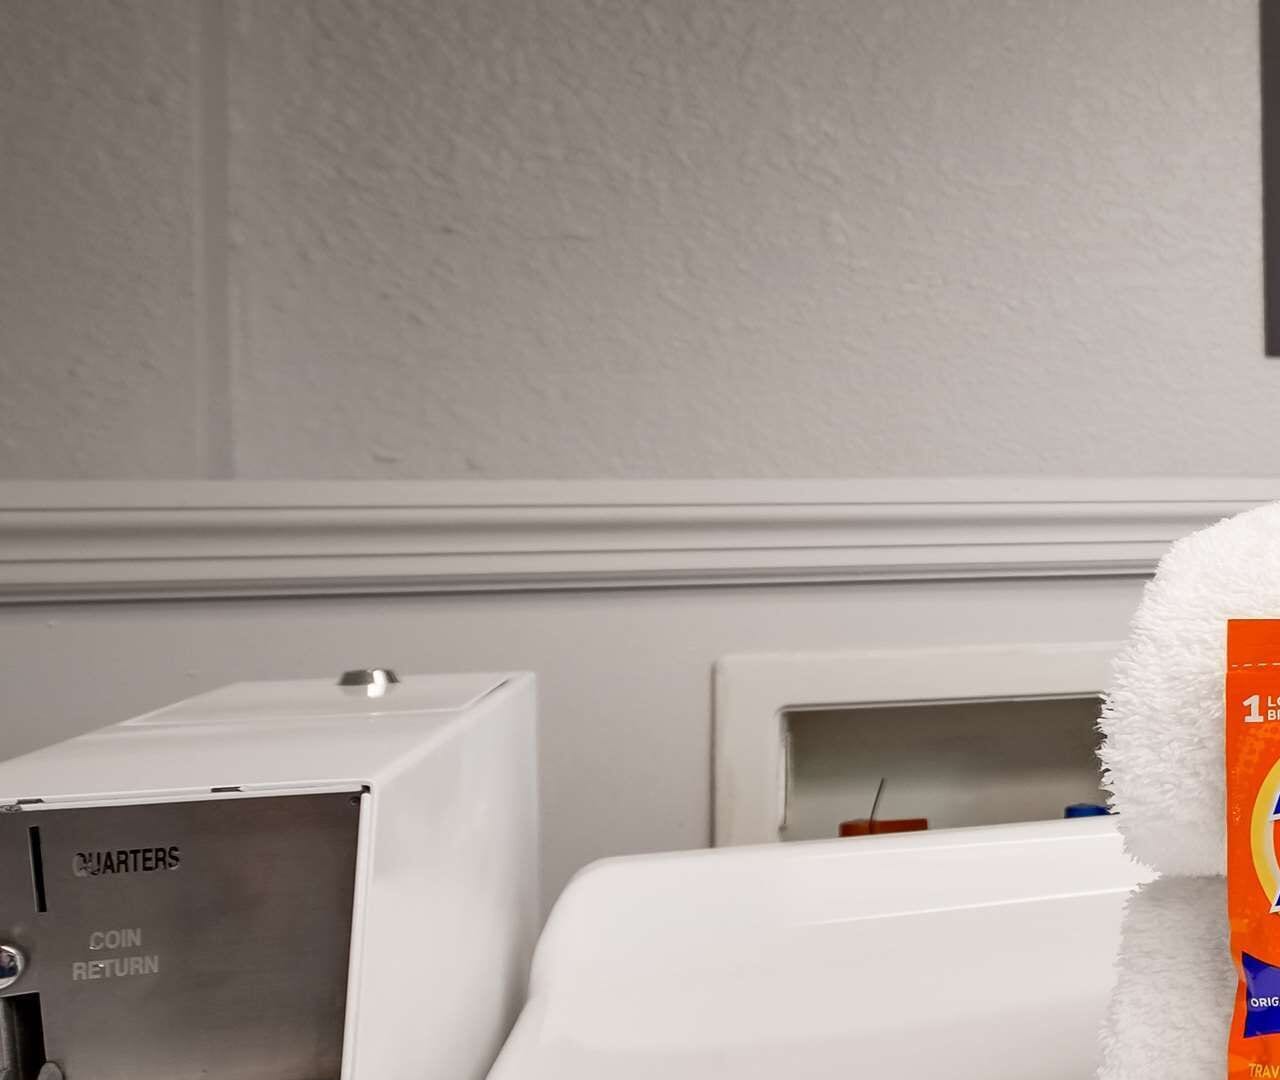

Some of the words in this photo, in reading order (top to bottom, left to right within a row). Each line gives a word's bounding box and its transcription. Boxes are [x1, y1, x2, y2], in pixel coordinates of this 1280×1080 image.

[1242, 694, 1264, 723] 1
[71, 846, 181, 877] QUARTERS
[89, 928, 142, 950] COIN
[72, 955, 160, 981] RETURN
